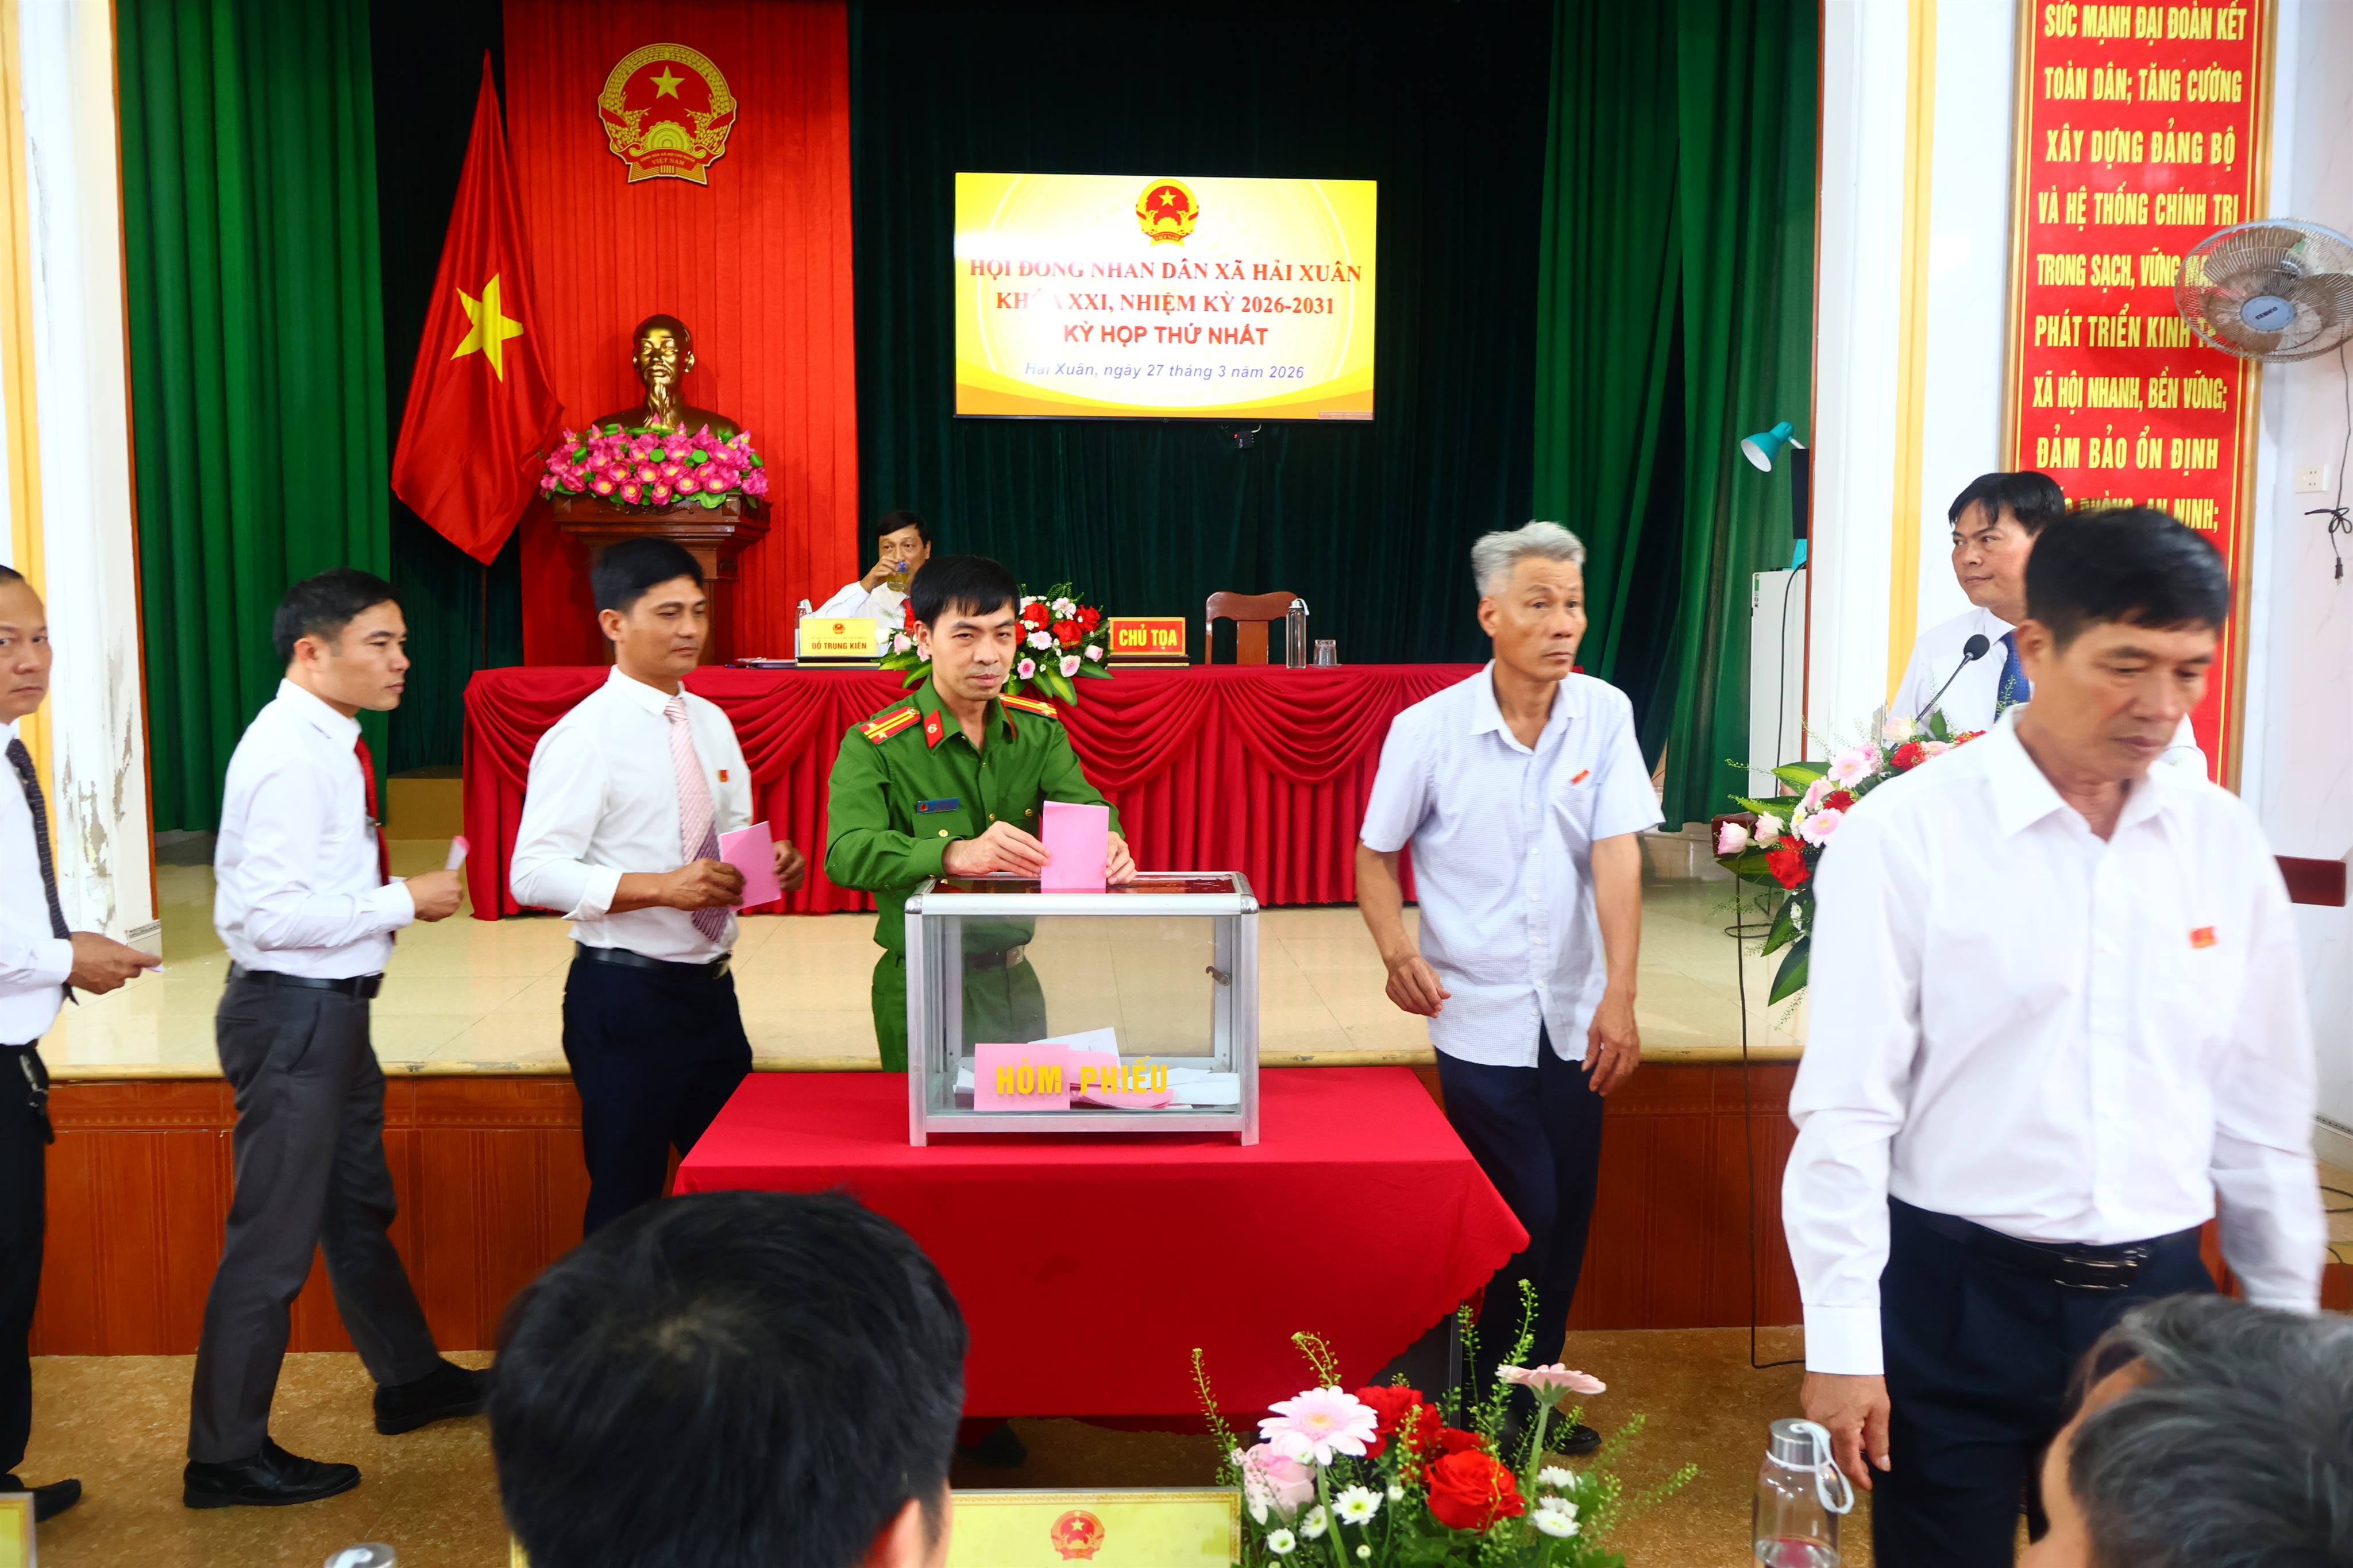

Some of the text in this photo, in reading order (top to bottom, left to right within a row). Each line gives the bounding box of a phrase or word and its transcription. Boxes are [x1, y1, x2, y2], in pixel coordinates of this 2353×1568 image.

[2044, 0, 2247, 46] SỨC MẠNH ĐẠI ĐOÀN KẾT
[2044, 60, 2242, 105] TOÀN DÂN; TĂNG CƯỜNG
[2045, 117, 2236, 171] XÂY DỰNG ĐẢNG BỘ
[2038, 184, 2059, 224] VÀ
[2065, 185, 2088, 231] HỆ
[2093, 181, 2148, 225] THỐNG
[2155, 186, 2207, 226] CHÍNH
[1162, 257, 1208, 279] DÂN
[1215, 259, 1245, 280] XÃ
[1253, 259, 1293, 281] HẢI
[1299, 260, 1361, 283] XUÂN
[2036, 253, 2086, 286] TRONG
[2090, 254, 2135, 293] SẠCH,
[2140, 246, 2181, 287] VỮNG
[1069, 293, 1114, 313] XXI,
[1120, 292, 1195, 316] NHIỆM
[1203, 291, 1235, 312] KỲ
[1241, 296, 1333, 314] 2026-2031
[2034, 308, 2082, 347] PHÁT
[2088, 303, 2141, 347] TRIỂN
[2147, 316, 2191, 347] KINH
[1064, 320, 1269, 347] KỲ HỌP THỨ NHẤT
[1055, 362, 1098, 378] Xuân,
[1104, 364, 1143, 380] ngày
[1146, 364, 1165, 377] 27
[1169, 364, 1213, 381] tháng
[1218, 365, 1226, 377] 3
[1231, 365, 1264, 378] năm
[1269, 365, 1304, 379] 2026
[2032, 366, 2227, 415] XÃ HỘI NHANH, BỀN VỮNG;
[2036, 423, 2219, 476] ĐẢM BẢO ỔN ĐỊNH
[1119, 624, 1178, 650] CHỦ TỌA
[1080, 1056, 1167, 1094] PHIẾU
